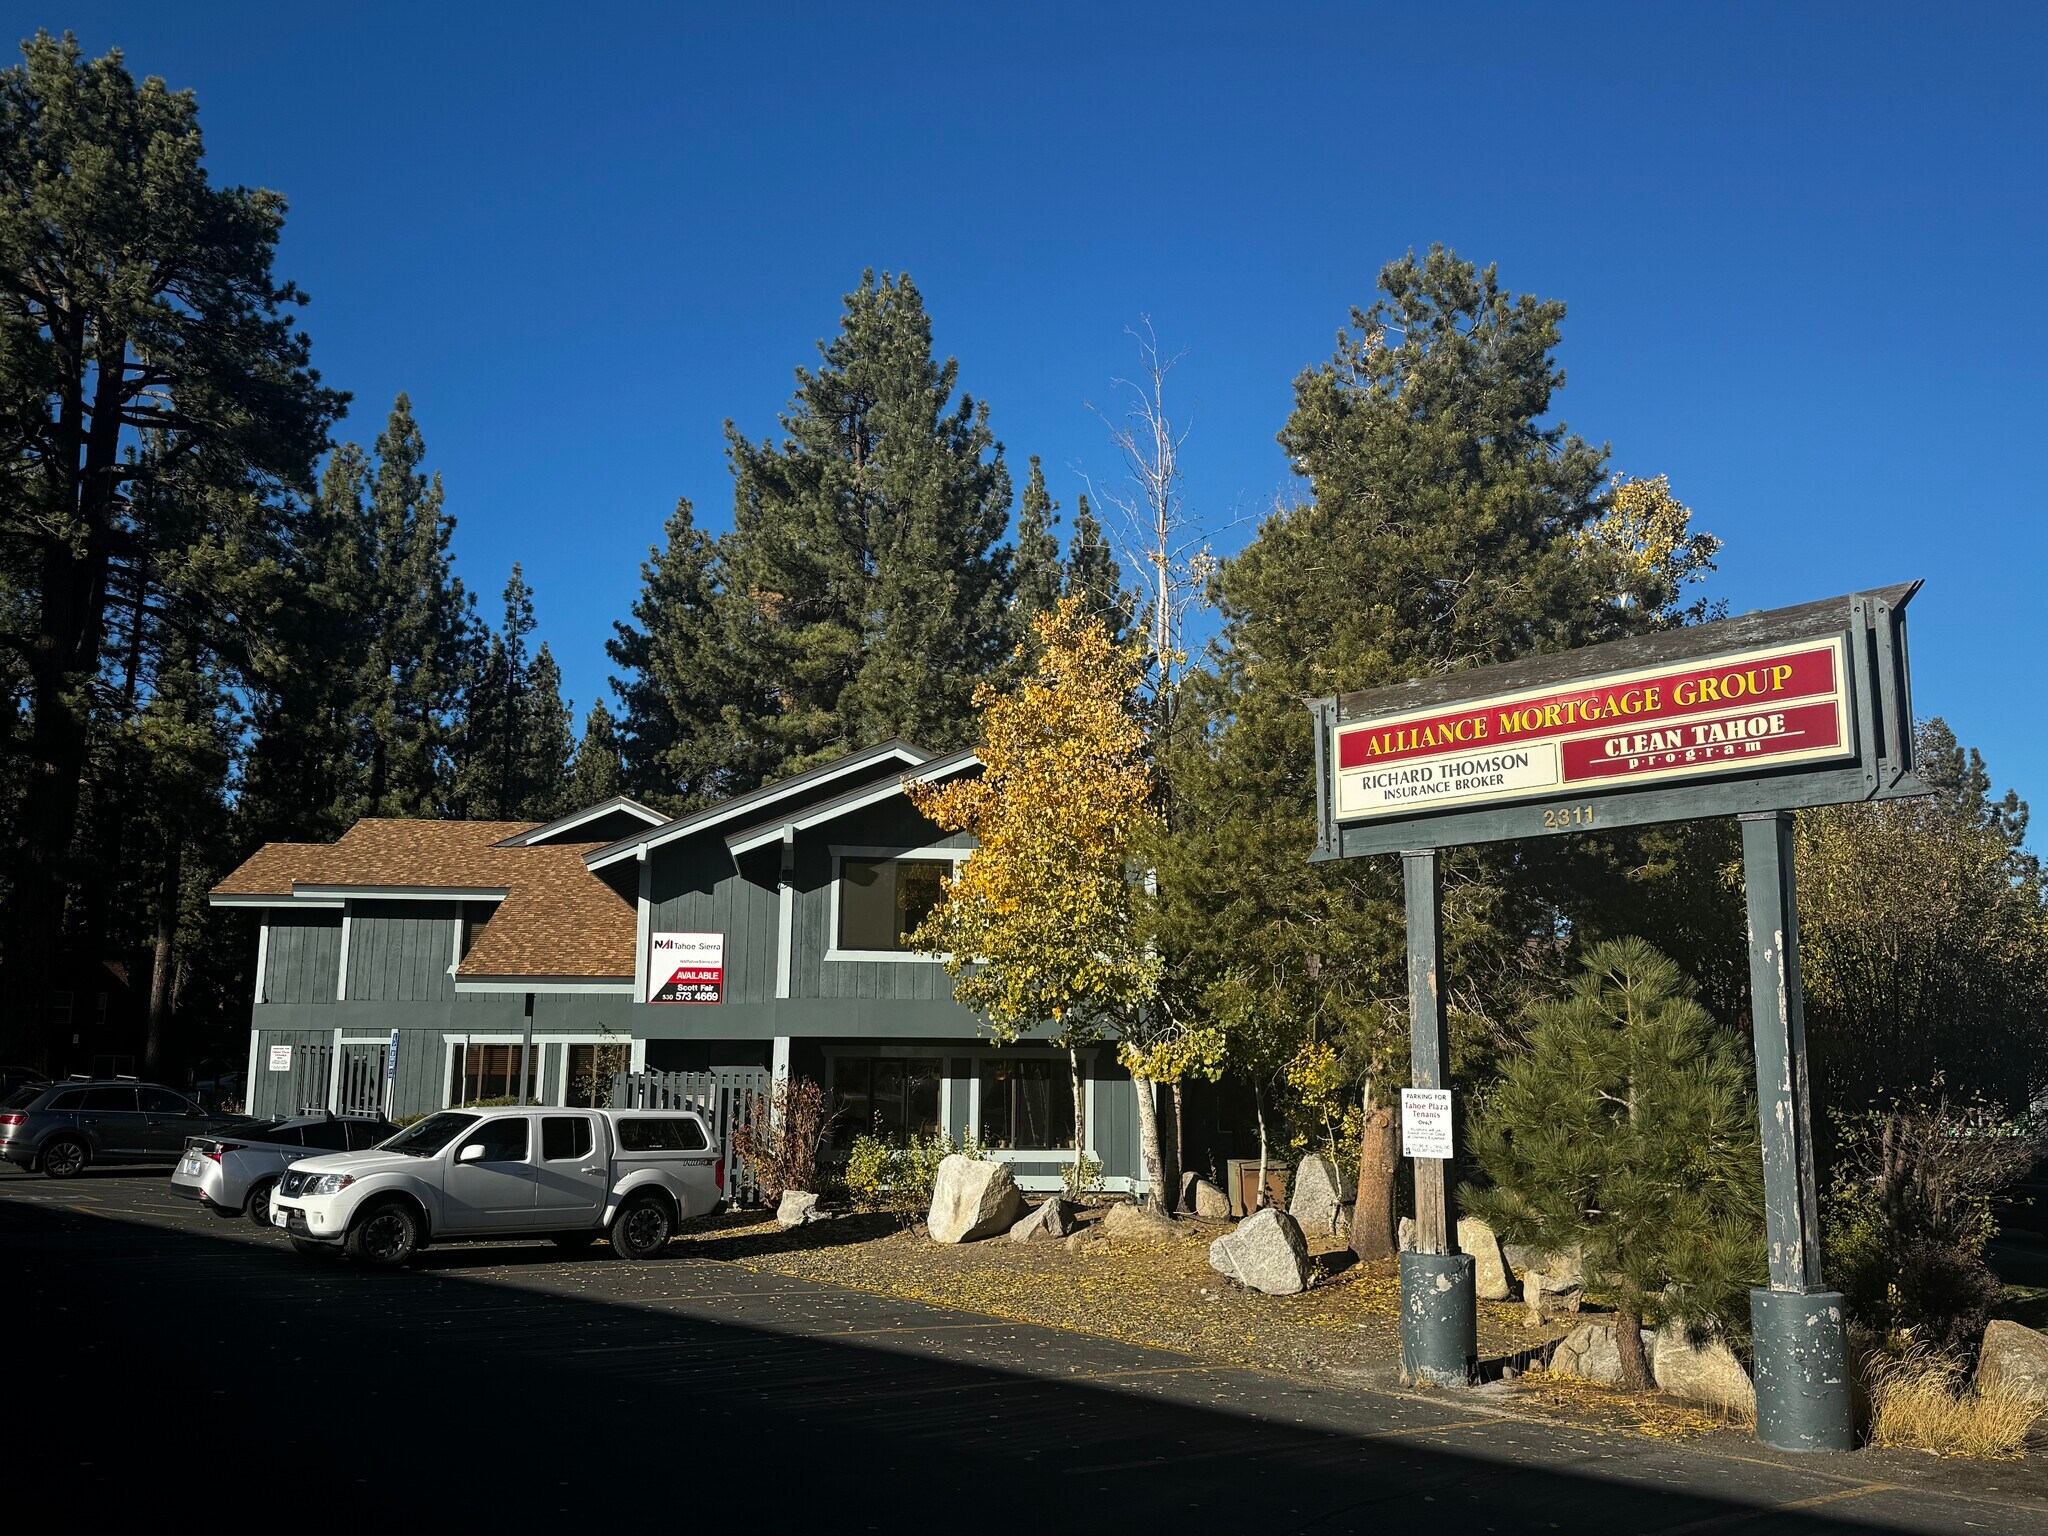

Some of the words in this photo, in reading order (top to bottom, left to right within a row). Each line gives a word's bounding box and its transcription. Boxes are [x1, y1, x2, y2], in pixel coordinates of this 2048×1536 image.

[1365, 716, 1489, 757] ALLIANCE
[1498, 686, 1662, 736] MORTGAGE
[1673, 664, 1793, 706] GROUP
[1605, 729, 1683, 757] CLEAN
[1691, 713, 1786, 744] TAHOE
[1362, 767, 1433, 790] RICHARD
[1438, 752, 1529, 779] THOMSON
[1384, 782, 1450, 800] INSURANCE
[1455, 773, 1504, 791] BROKER
[1543, 805, 1594, 828] 2311
[654, 939, 673, 949] NAI
[675, 992, 692, 1001] 573
[694, 992, 719, 1001] 4669
[1413, 1110, 1440, 1118] Tenants
